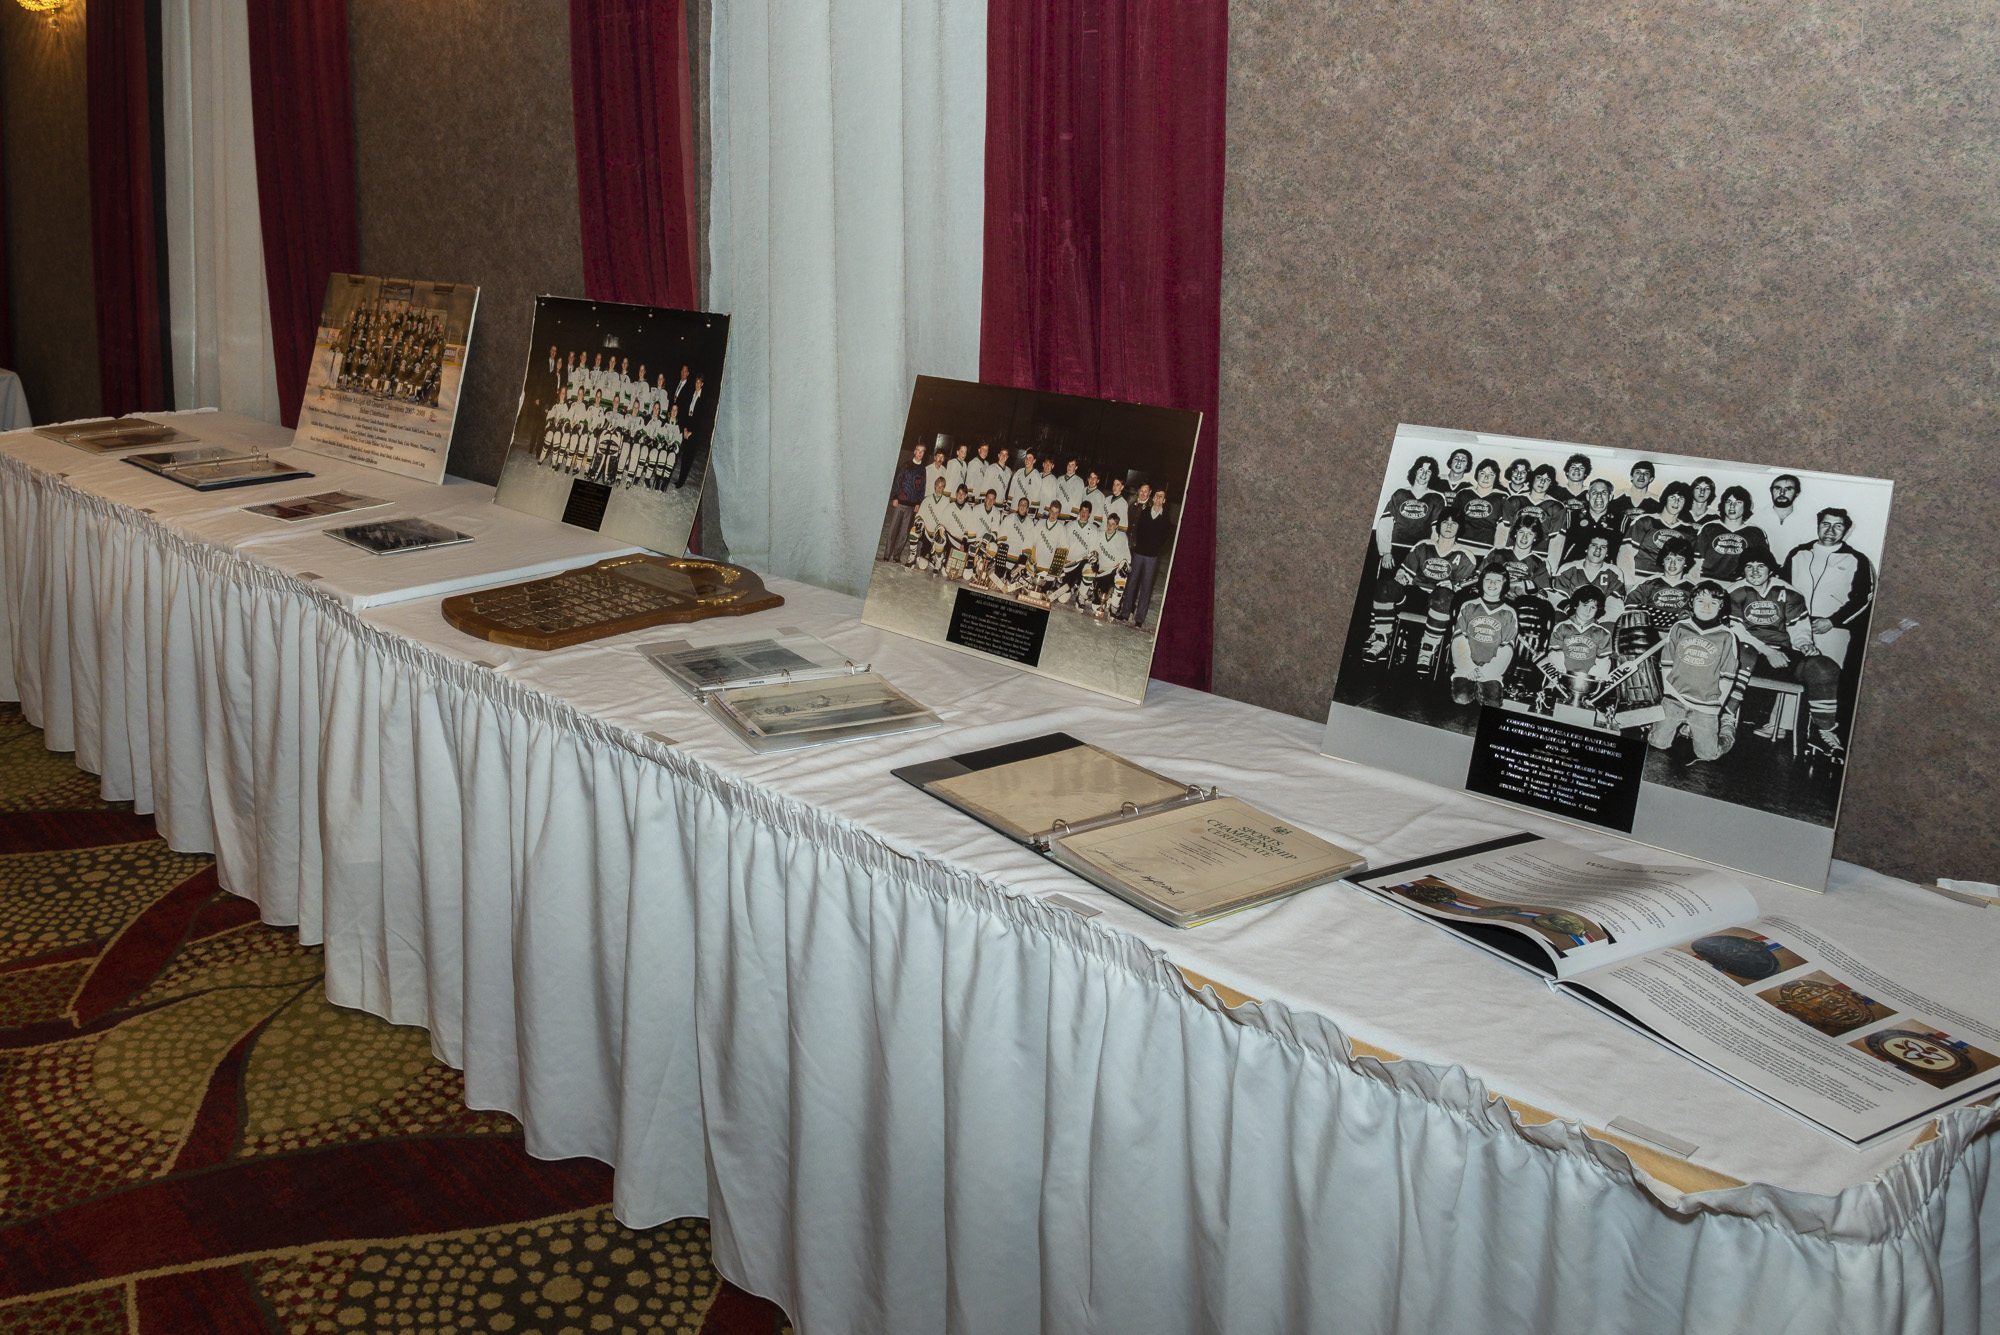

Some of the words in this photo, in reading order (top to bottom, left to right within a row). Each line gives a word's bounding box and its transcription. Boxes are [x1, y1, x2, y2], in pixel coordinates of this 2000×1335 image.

[1452, 554, 1461, 566] A
[1600, 574, 1608, 586] C
[1778, 590, 1786, 602] A
[1536, 725, 1582, 740] WHOLESALERS
[1584, 736, 1616, 748] BANTAMS
[1539, 734, 1566, 744] BANTAM
[1584, 744, 1622, 758] CHAMPIONS
[1207, 819, 1297, 860] CHAMPIONSHIP
[1207, 828, 1274, 857] CERTIFICATE
[1238, 826, 1284, 846] SPORTS
